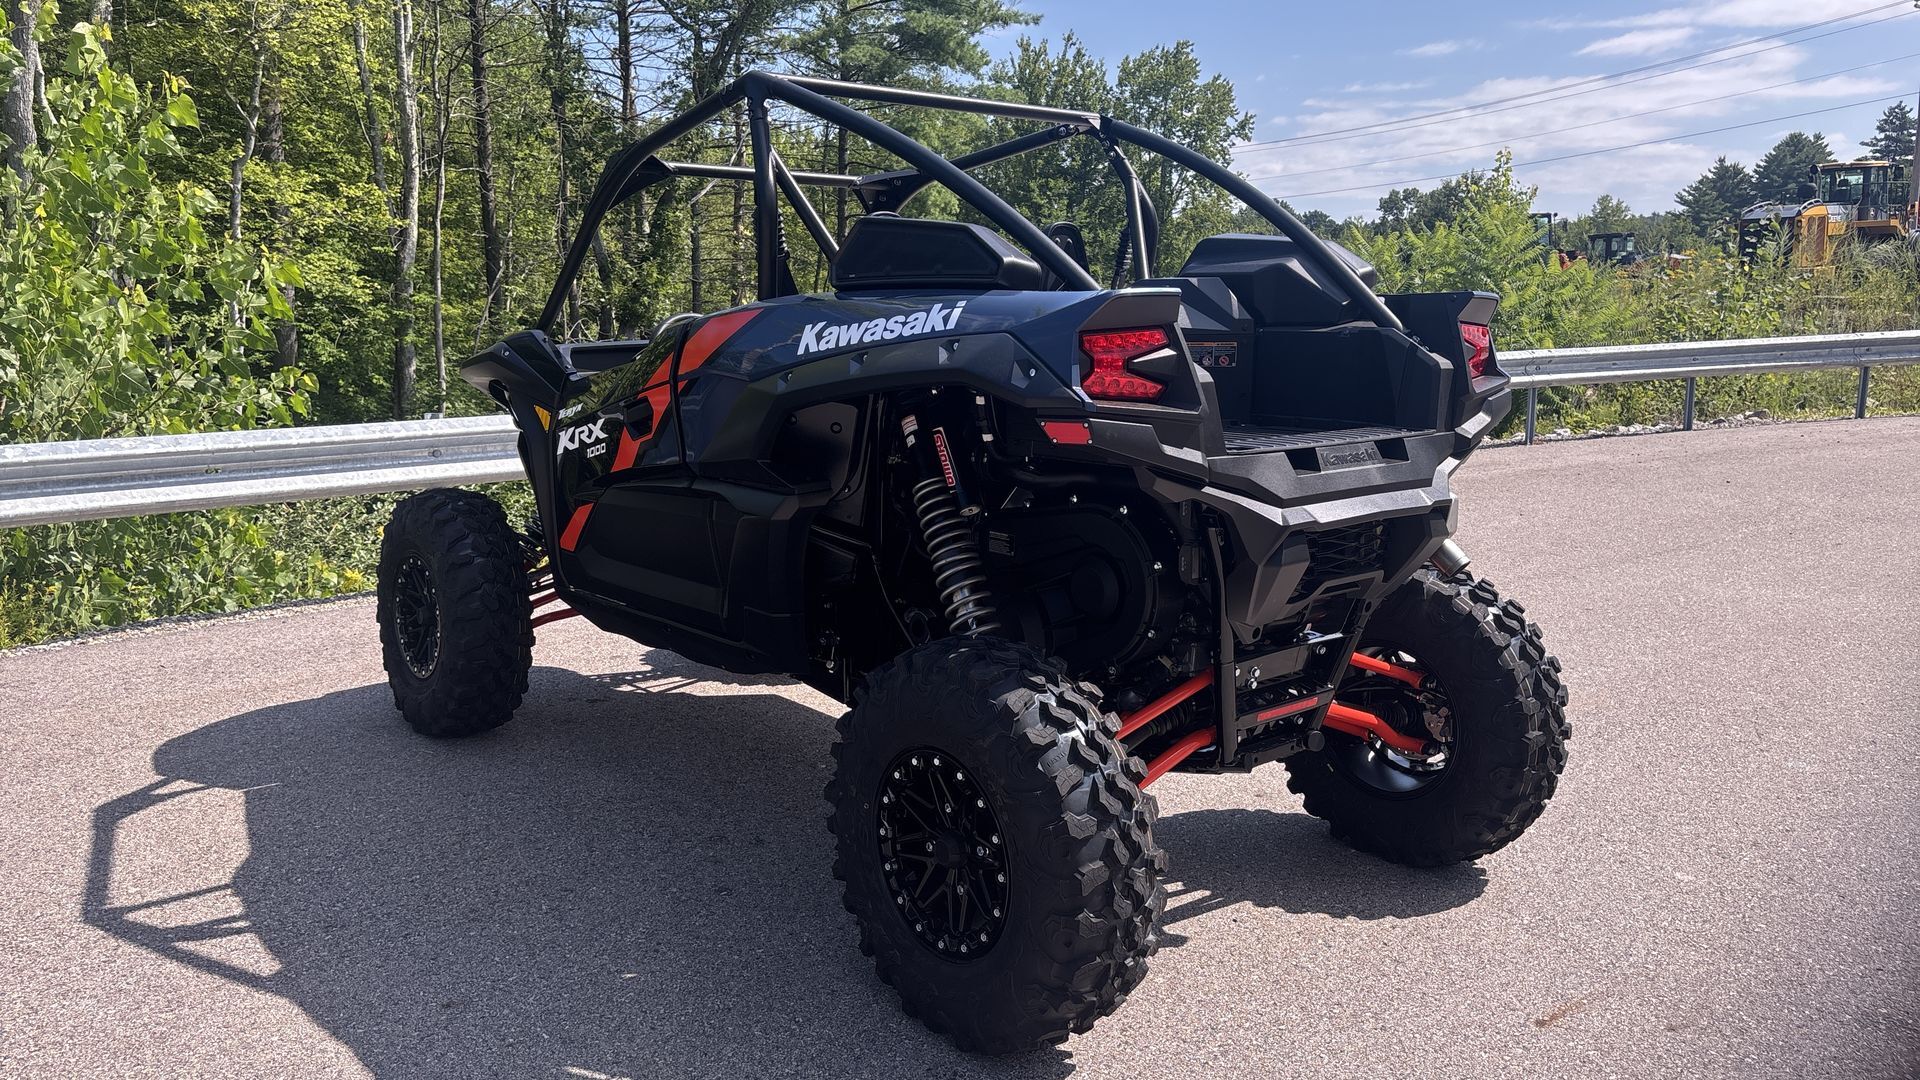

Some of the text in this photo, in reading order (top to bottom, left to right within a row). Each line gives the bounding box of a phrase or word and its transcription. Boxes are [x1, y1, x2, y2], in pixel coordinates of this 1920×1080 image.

[797, 301, 967, 355] Kawasaki
[557, 418, 608, 455] KRX
[587, 443, 606, 458] 1000
[1320, 447, 1378, 466] Kawasaki
